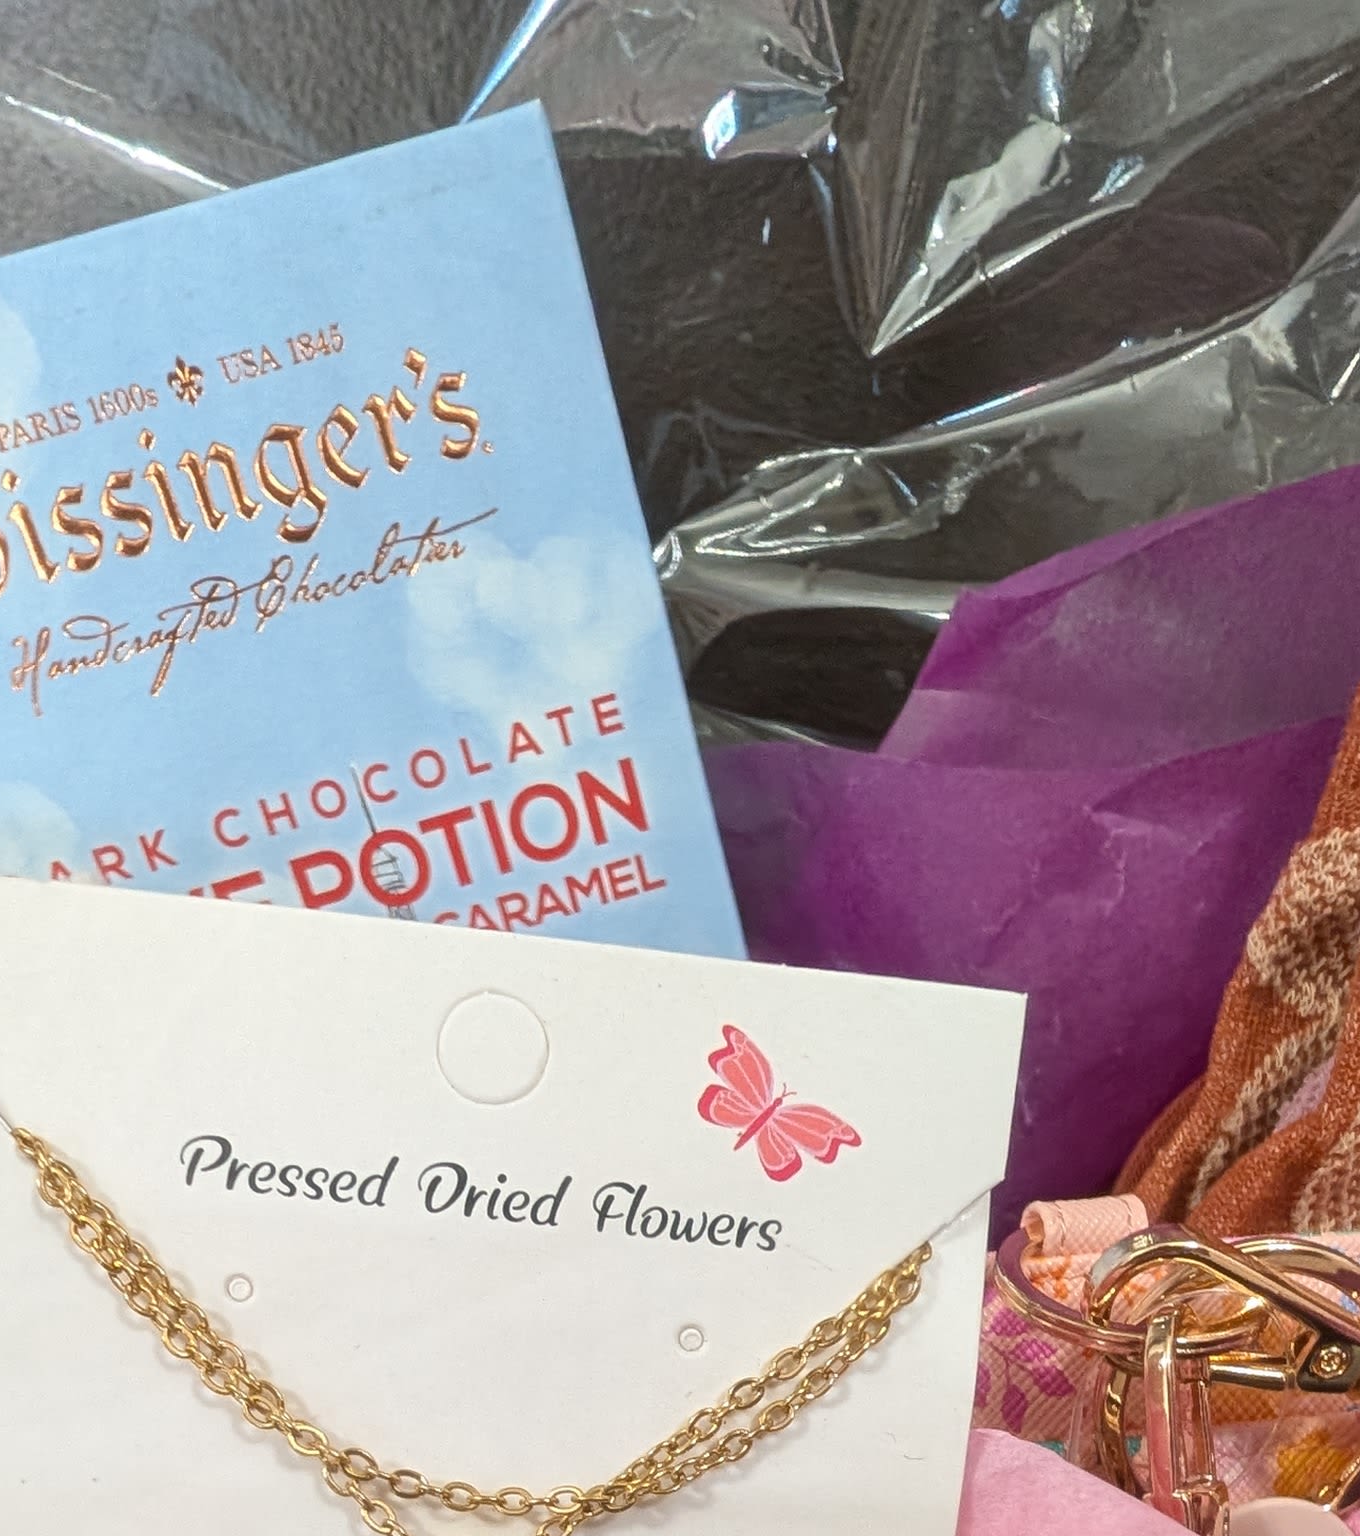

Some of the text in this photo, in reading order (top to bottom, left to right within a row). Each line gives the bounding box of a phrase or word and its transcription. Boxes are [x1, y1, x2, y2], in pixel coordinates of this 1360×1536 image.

[87, 383, 160, 425] 1600s
[216, 344, 283, 385] USA
[287, 321, 345, 366] 1845
[9, 507, 498, 717] Handcrafted Chocolatier
[4, 693, 625, 885] ARK CHOCOLATE
[288, 757, 651, 910] POTION
[179, 1134, 783, 1252] Pressed Dried Flowers
